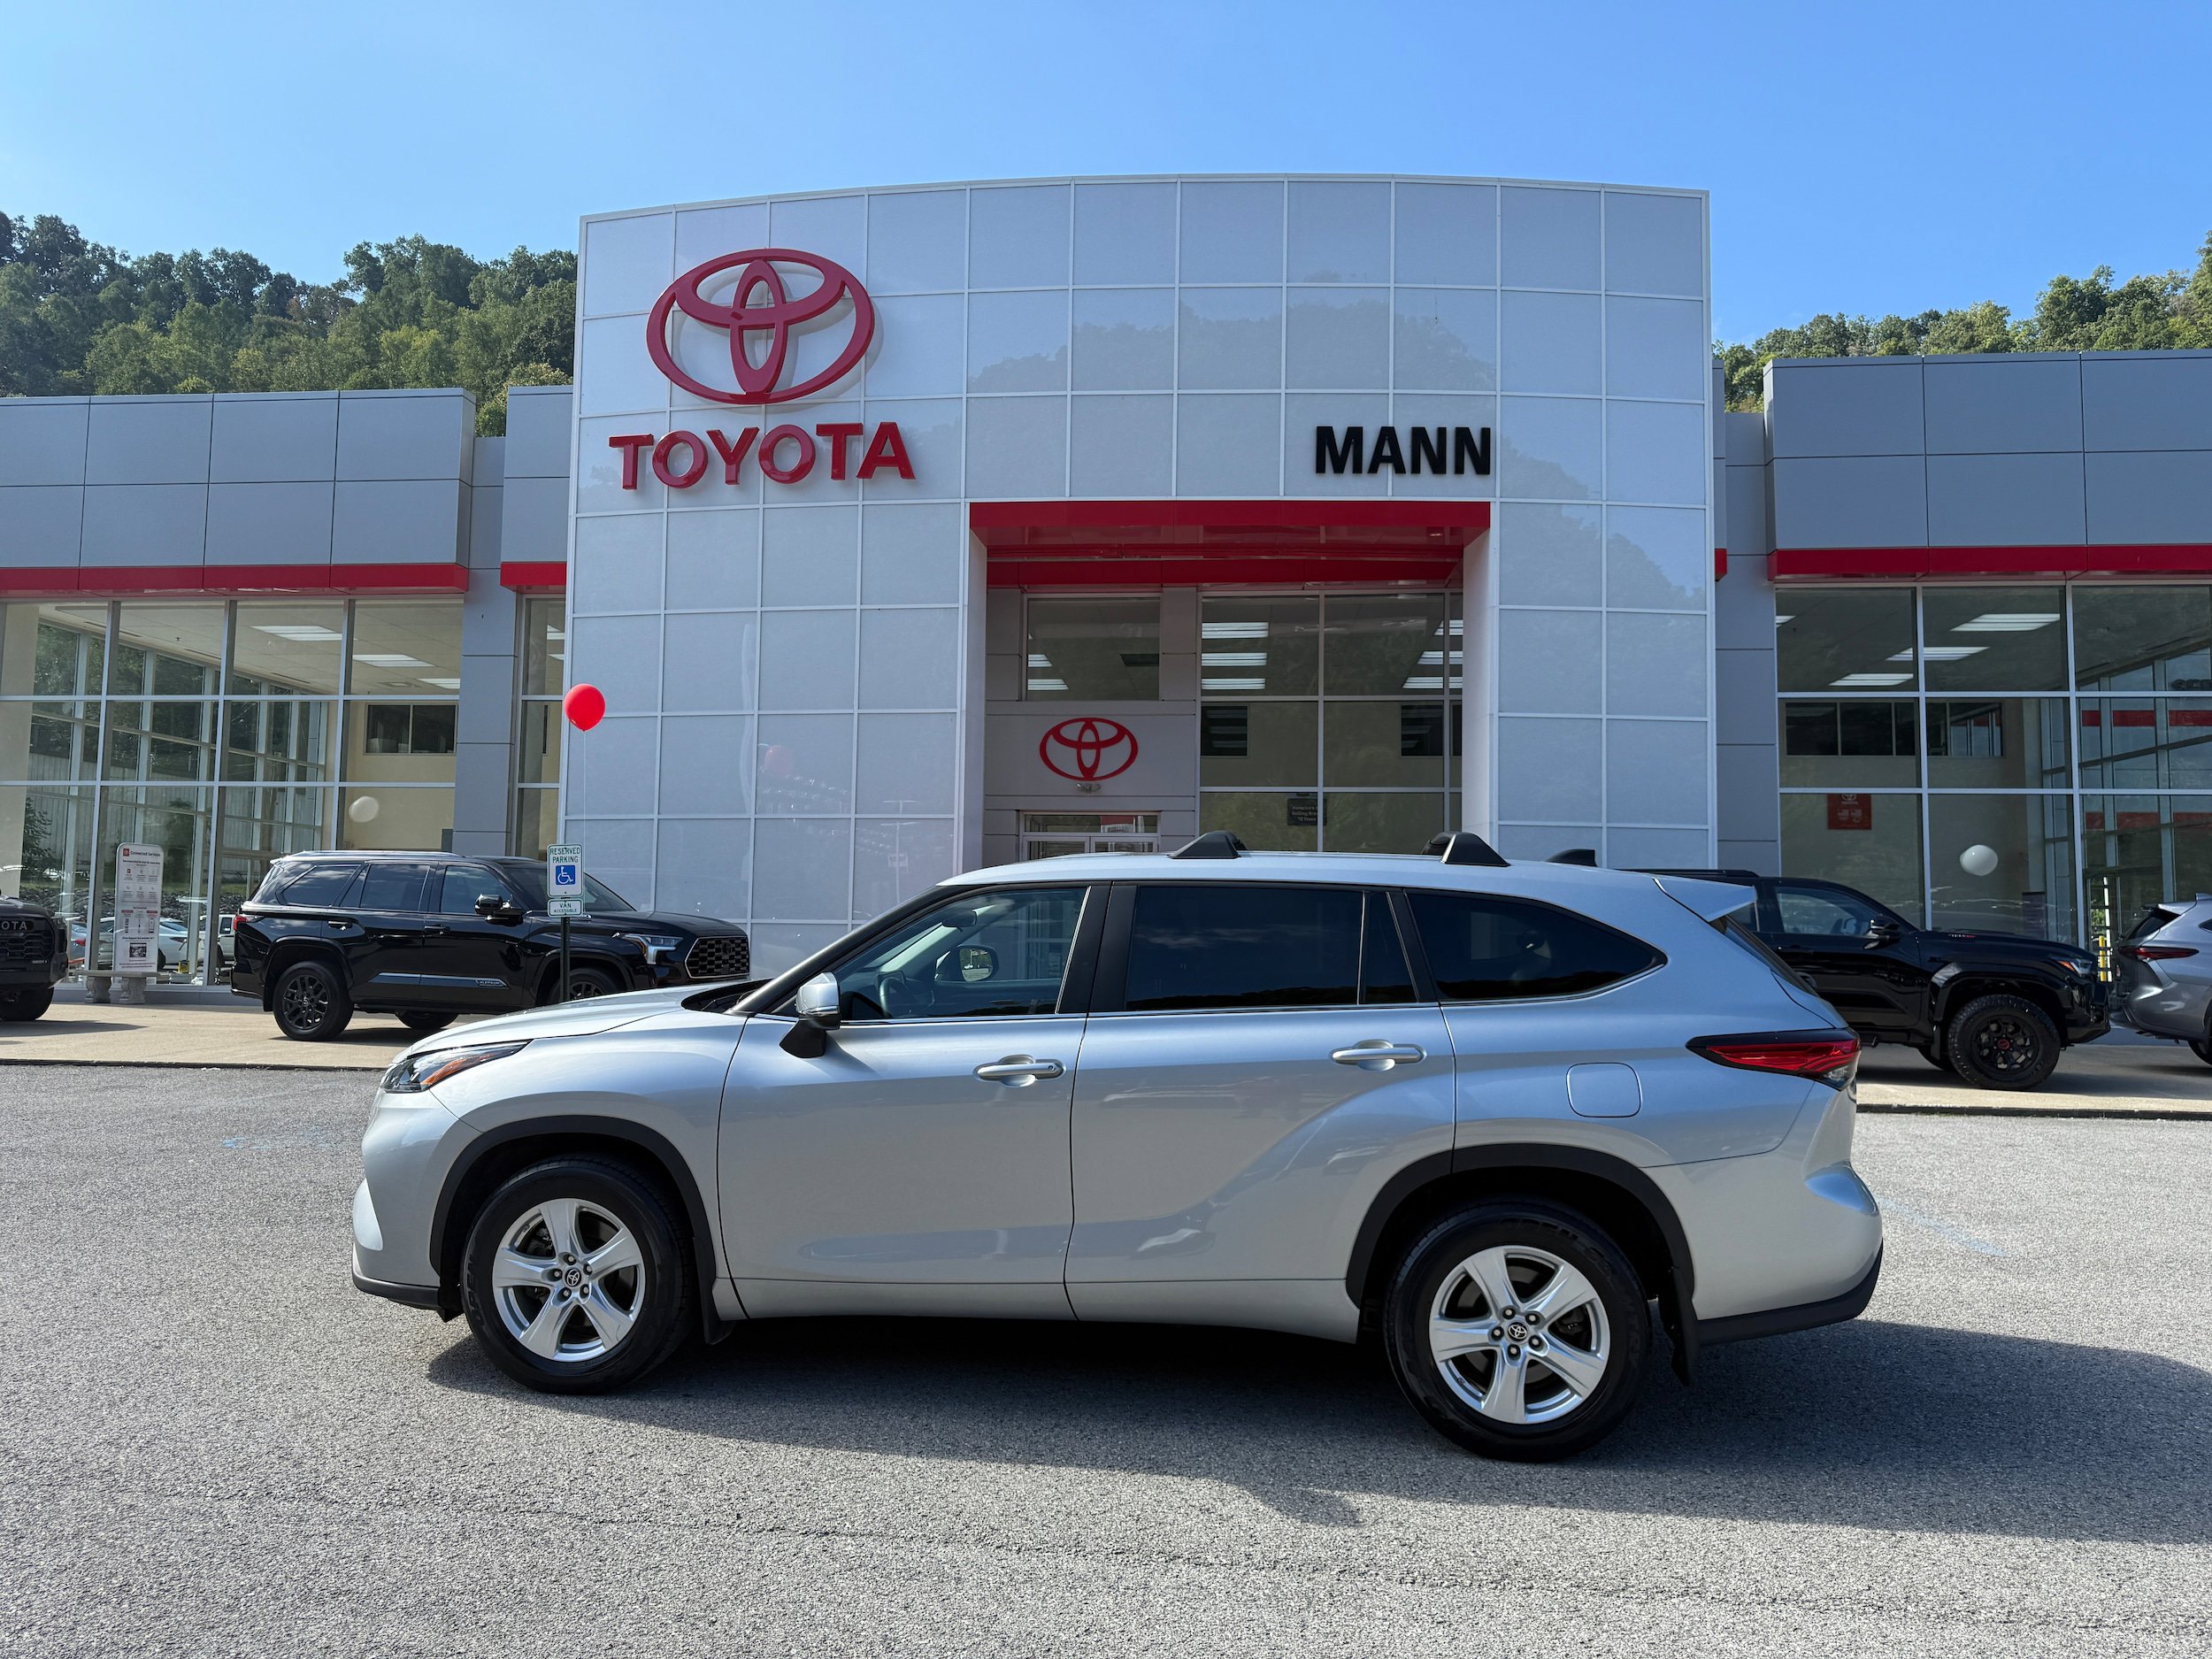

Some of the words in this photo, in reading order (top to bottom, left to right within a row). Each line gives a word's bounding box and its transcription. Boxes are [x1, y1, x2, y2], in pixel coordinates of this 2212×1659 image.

[609, 421, 916, 490] TOYOTA
[1316, 426, 1491, 475] MANN
[549, 847, 580, 856] RESERVED
